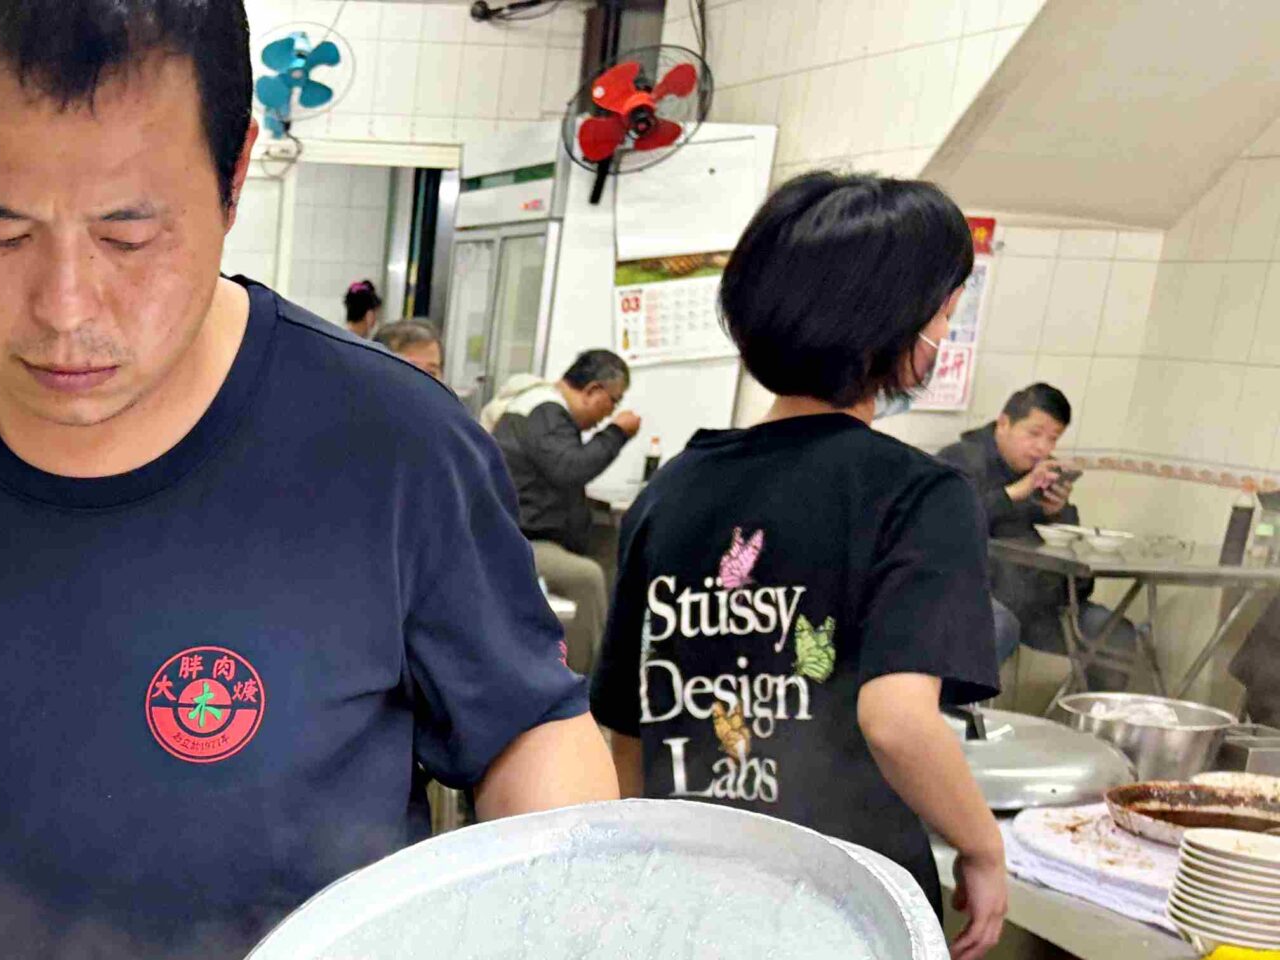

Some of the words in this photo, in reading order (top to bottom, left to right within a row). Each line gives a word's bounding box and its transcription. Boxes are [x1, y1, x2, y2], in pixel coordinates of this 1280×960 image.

[621, 296, 641, 314] 03
[647, 575, 806, 652] Stüssy
[187, 681, 223, 728] 木
[639, 656, 812, 738] Design
[662, 736, 778, 803] Labs
